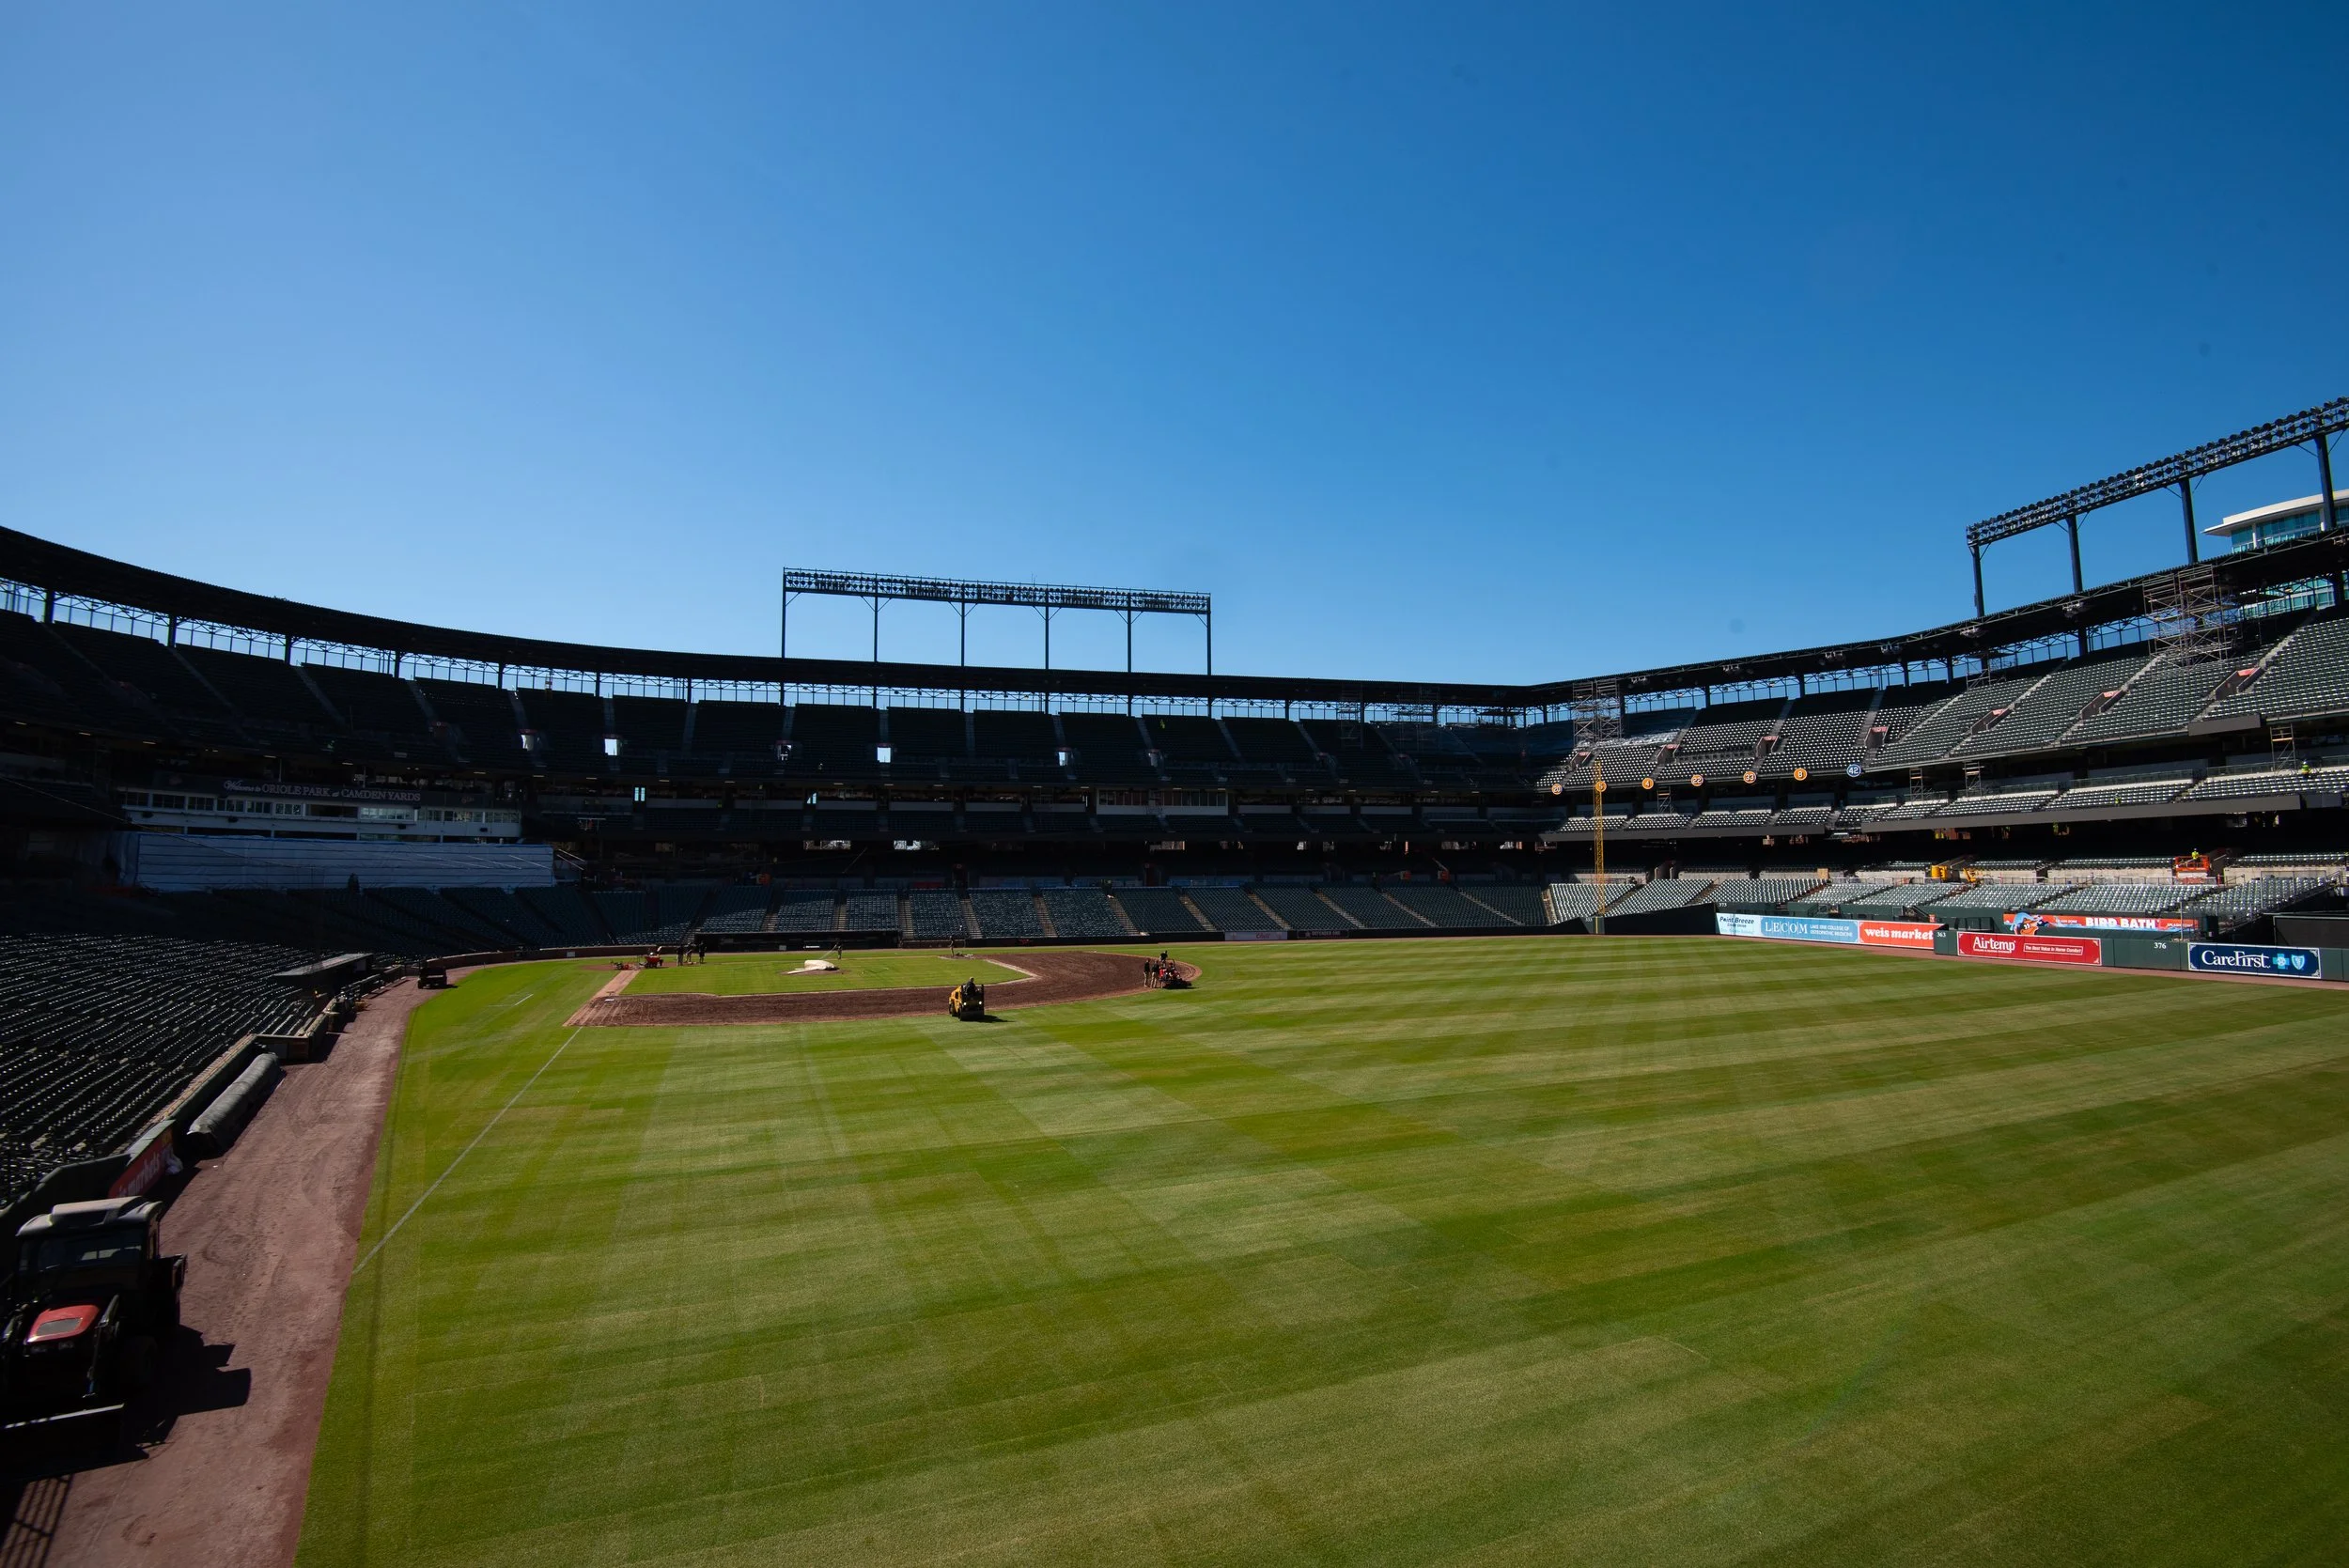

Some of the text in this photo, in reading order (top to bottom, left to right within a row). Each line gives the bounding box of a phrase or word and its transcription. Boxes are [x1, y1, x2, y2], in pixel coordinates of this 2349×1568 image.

[262, 783, 302, 796] ORIOLE
[302, 785, 331, 798] PARK
[341, 788, 385, 801] CAMDEN
[385, 791, 421, 802] YARDS
[2085, 917, 2157, 930] BIRD BATH
[1864, 927, 1934, 940] weis market
[1972, 936, 2016, 952] Airtemp
[2201, 950, 2269, 969] CareFirst
